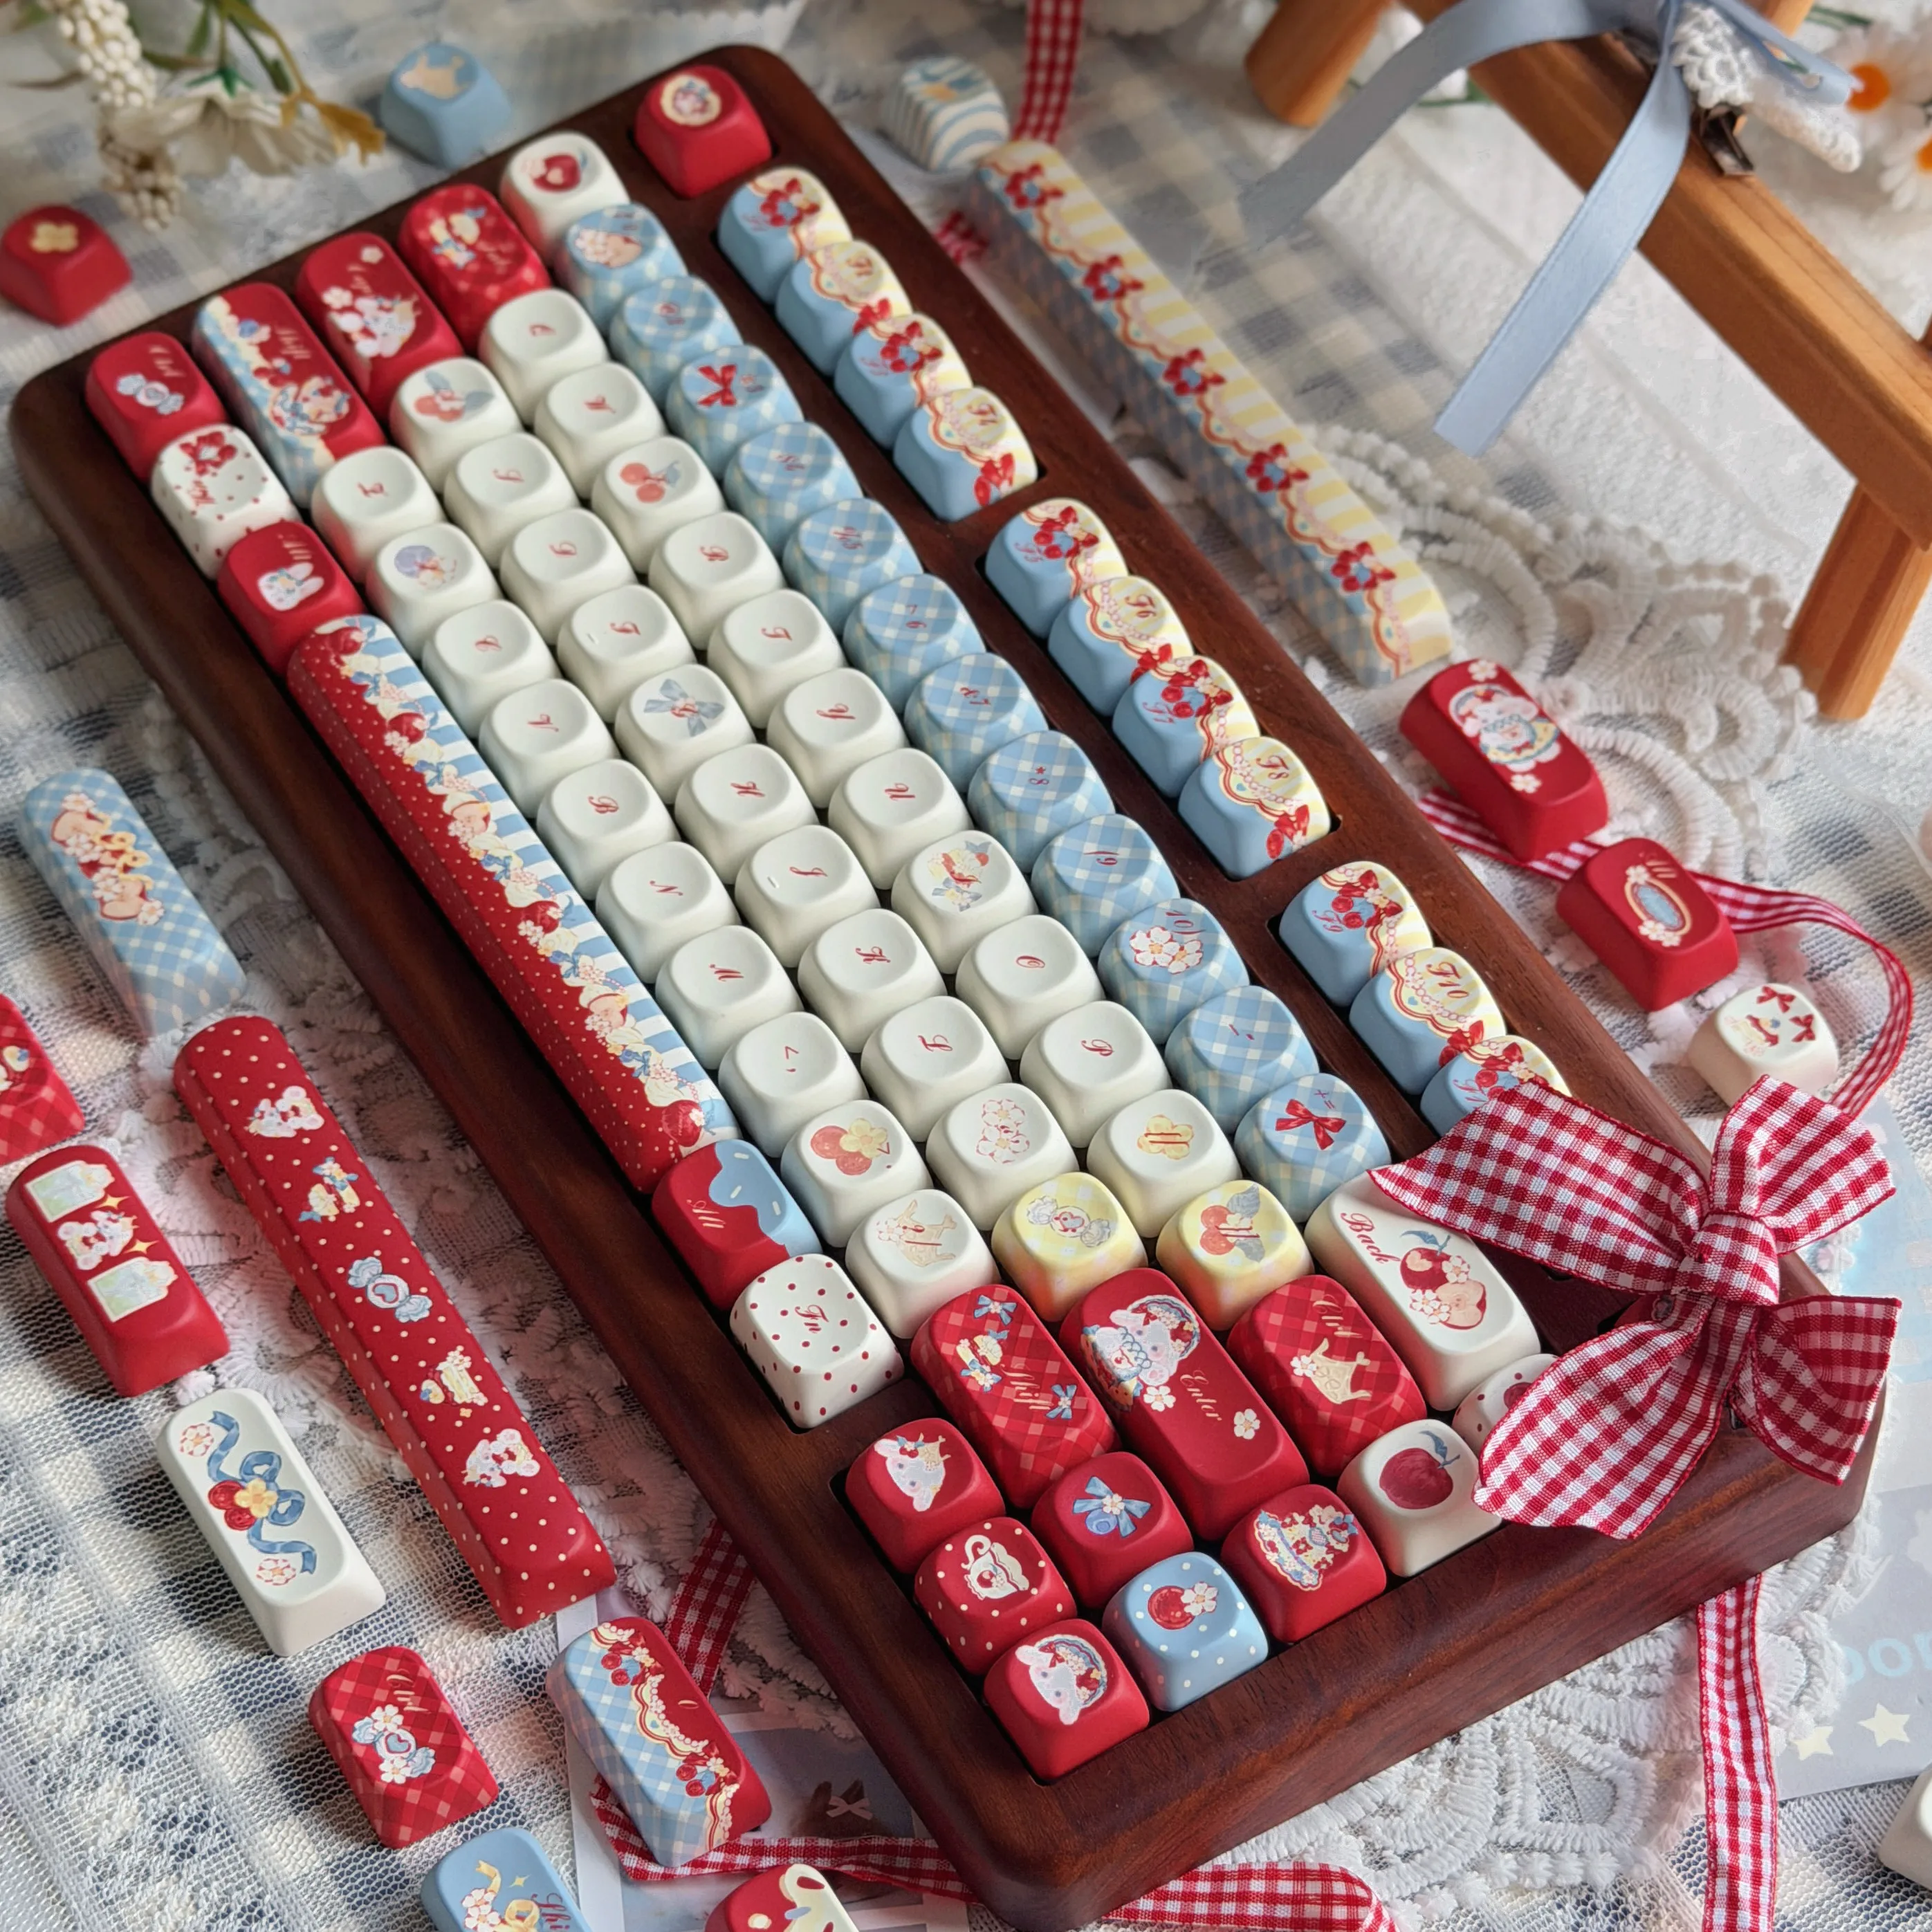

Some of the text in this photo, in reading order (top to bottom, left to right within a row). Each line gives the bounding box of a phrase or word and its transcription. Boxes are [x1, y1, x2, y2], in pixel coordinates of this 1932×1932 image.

[699, 546, 729, 561] R
[1125, 596, 1155, 619] F6
[760, 627, 792, 640] T
[816, 704, 855, 720] Y
[1143, 701, 1175, 724] F7
[1255, 756, 1288, 780] F8
[731, 781, 764, 798] H
[884, 783, 916, 800] U
[587, 796, 618, 814] B
[789, 866, 827, 877] J
[648, 880, 683, 896] N
[1312, 909, 1347, 933] F9
[855, 946, 890, 964] K
[1015, 955, 1045, 967] O
[709, 964, 744, 981] M
[1426, 962, 1468, 999] F10
[918, 1034, 953, 1051] L
[1082, 1039, 1114, 1058] P
[1453, 1078, 1489, 1103] F1
[687, 1199, 725, 1229] Alt
[1340, 1213, 1406, 1262] Back
[794, 1305, 829, 1333] Fn
[1312, 1294, 1360, 1338] Ctrl
[1000, 1361, 1052, 1410] Shift
[1180, 1370, 1222, 1421] Enter
[385, 1667, 430, 1712] Ctrl
[531, 1892, 571, 1929] Shi
